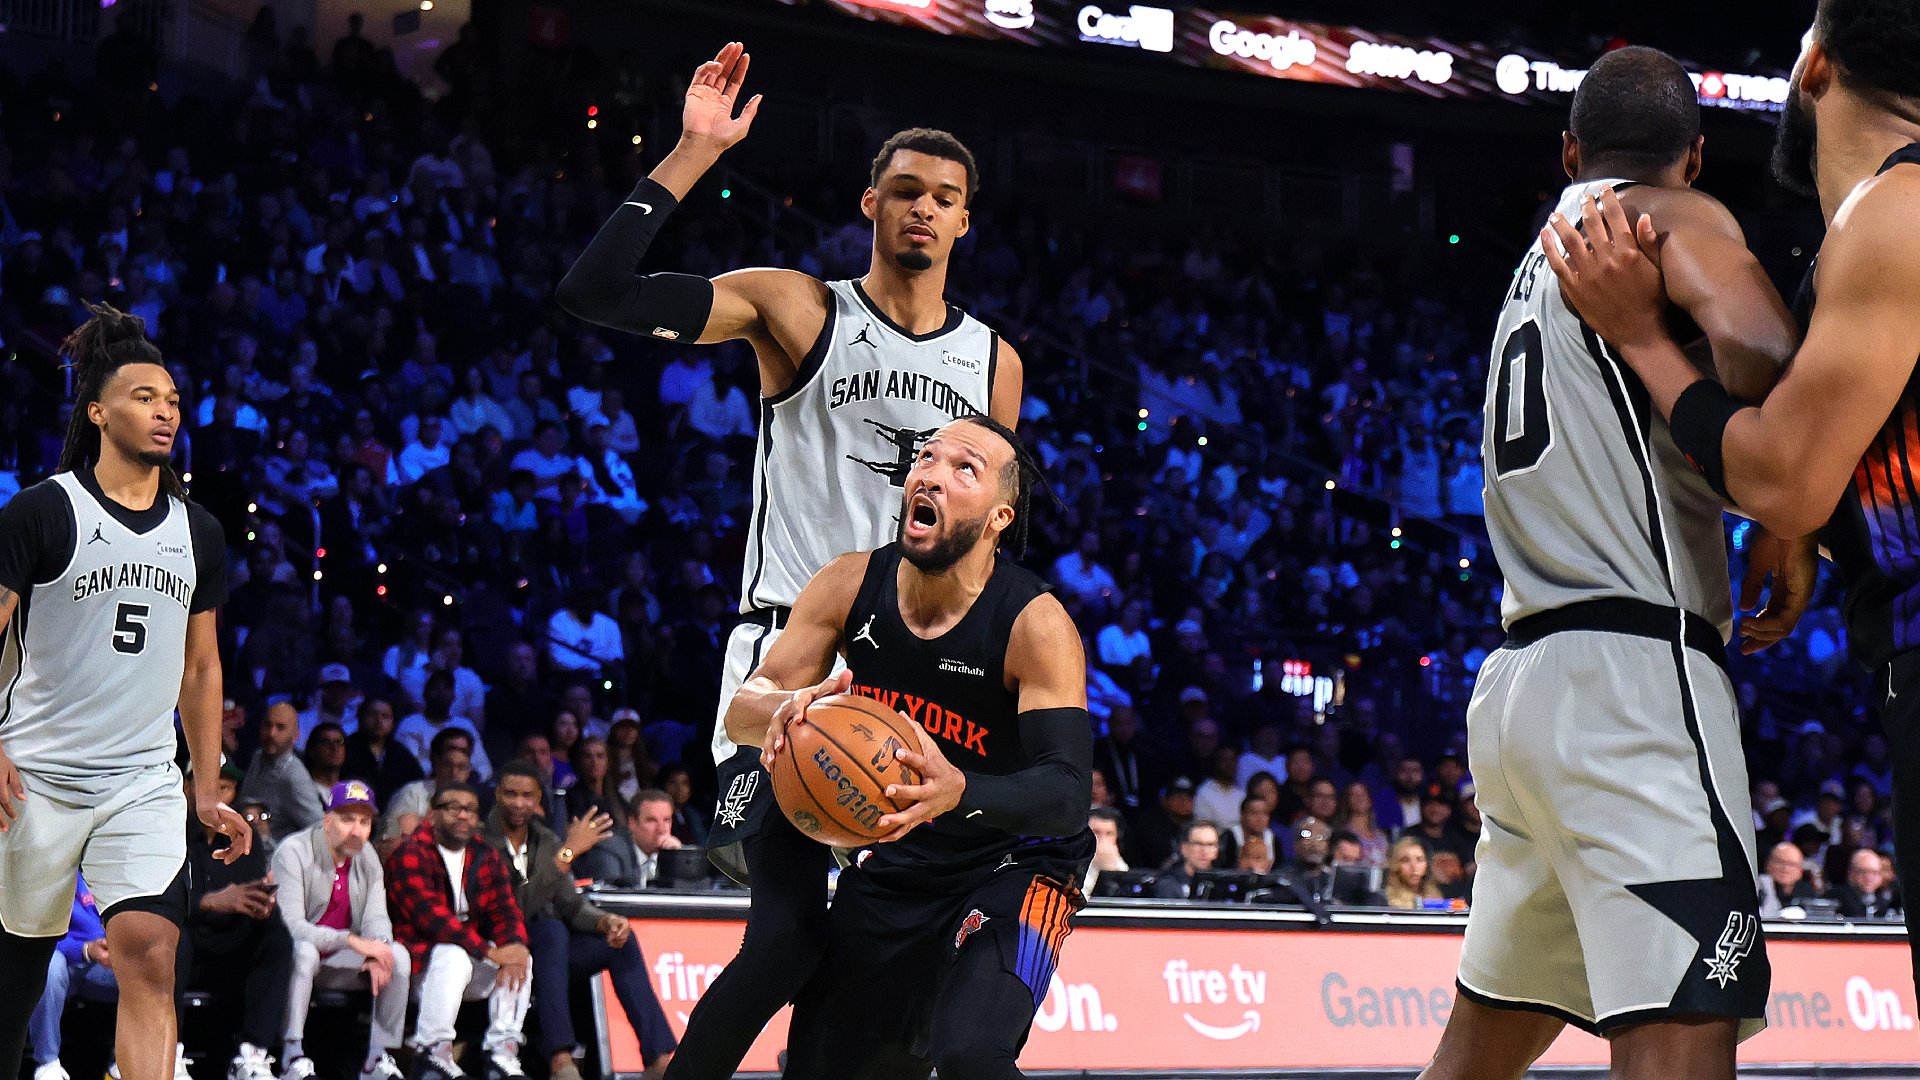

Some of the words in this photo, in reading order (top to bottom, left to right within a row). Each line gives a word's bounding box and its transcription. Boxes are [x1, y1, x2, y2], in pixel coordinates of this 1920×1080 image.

[1209, 20, 1316, 70] Google
[947, 355, 976, 370] LEDGER
[829, 369, 881, 410] SAN
[73, 565, 114, 601] SAN
[117, 562, 191, 610] ANTONIO
[110, 601, 151, 656] 5
[938, 662, 957, 672] abu
[957, 664, 985, 677] dhabi
[903, 693, 990, 758] YORK
[812, 746, 887, 832] Wilson
[1033, 971, 1119, 1032] On.
[1162, 959, 1228, 1005] fire
[1229, 962, 1267, 1005] tv
[1321, 971, 1452, 1028] Game
[1766, 991, 1846, 1029] me.
[1845, 975, 1915, 1032] On.
